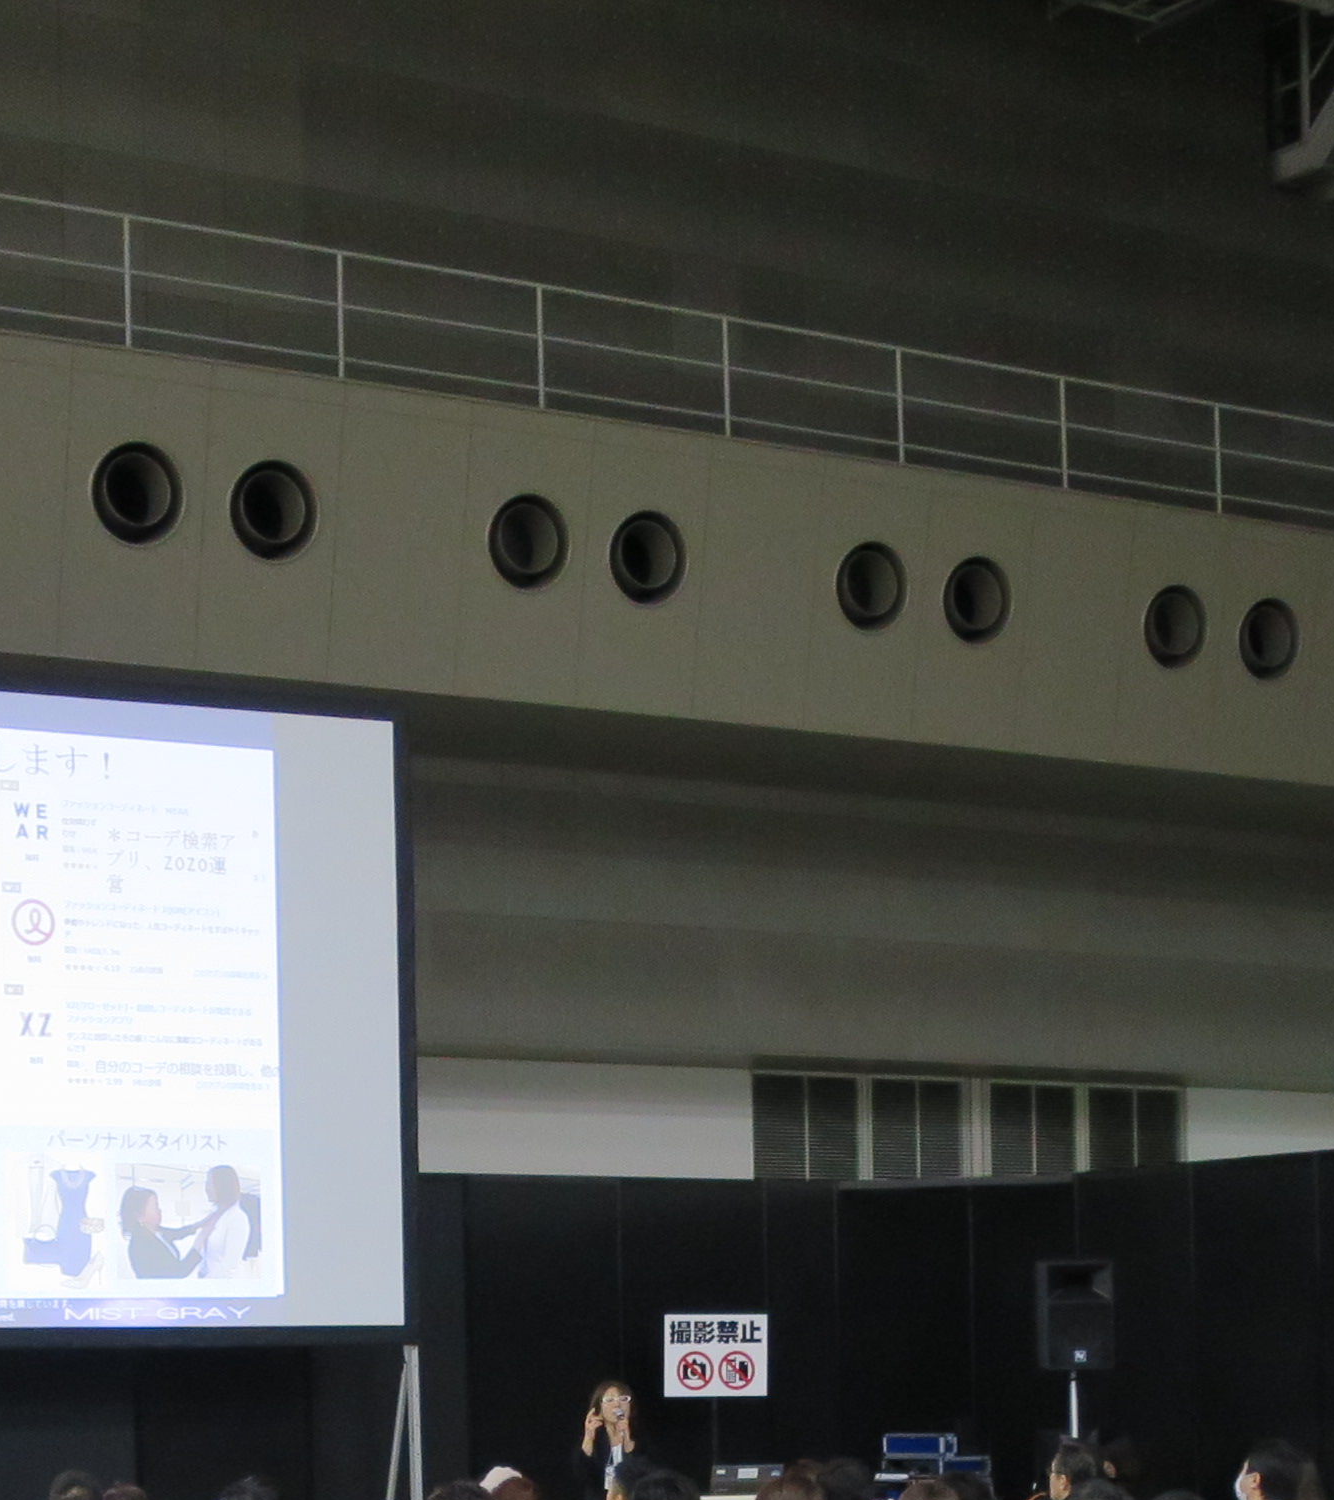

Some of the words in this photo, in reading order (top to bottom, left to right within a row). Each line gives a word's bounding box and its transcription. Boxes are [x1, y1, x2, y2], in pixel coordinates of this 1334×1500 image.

[47, 1130, 228, 1151] パーソナルスタイリスト
[64, 1307, 145, 1320] MIST
[155, 1305, 251, 1320] GRAY
[670, 1320, 762, 1344] 撮影禁止
